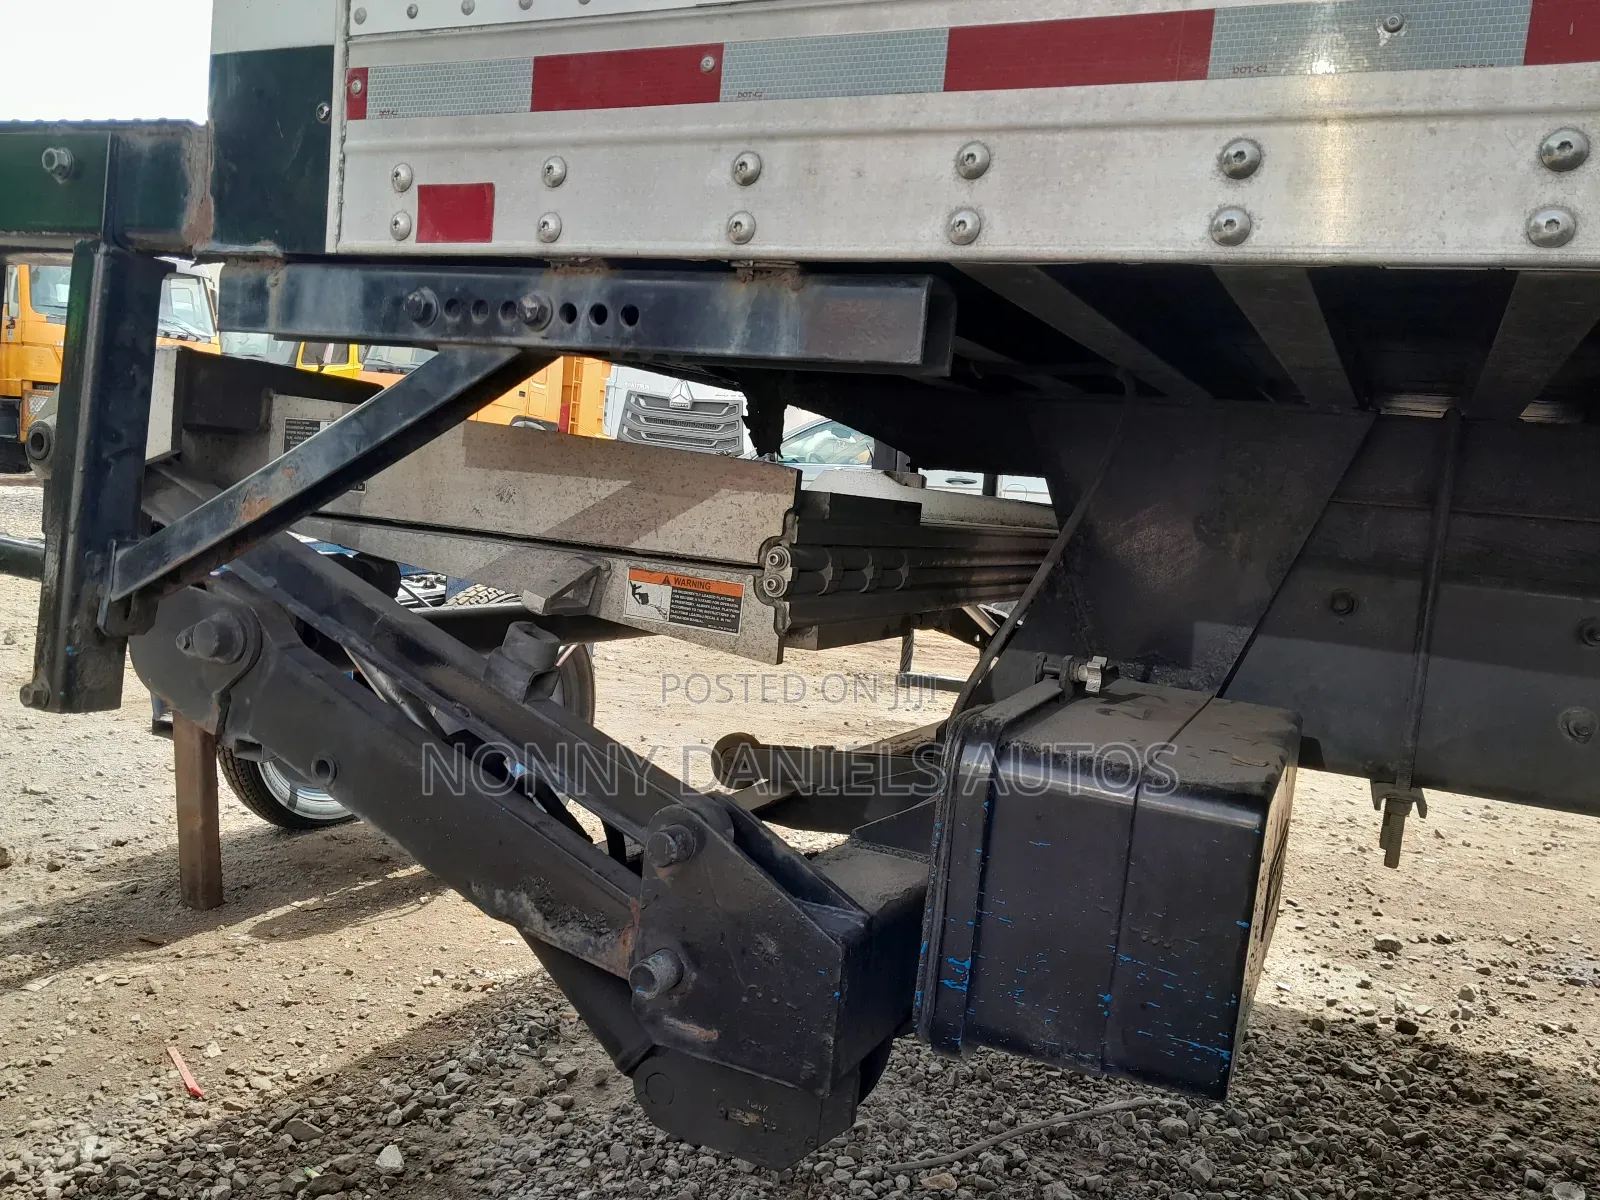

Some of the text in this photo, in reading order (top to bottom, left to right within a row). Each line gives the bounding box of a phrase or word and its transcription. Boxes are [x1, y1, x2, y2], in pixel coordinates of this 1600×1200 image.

[1232, 65, 1268, 74] DOT-C2
[737, 91, 763, 99] DOT-C2
[674, 577, 711, 590] WARNING
